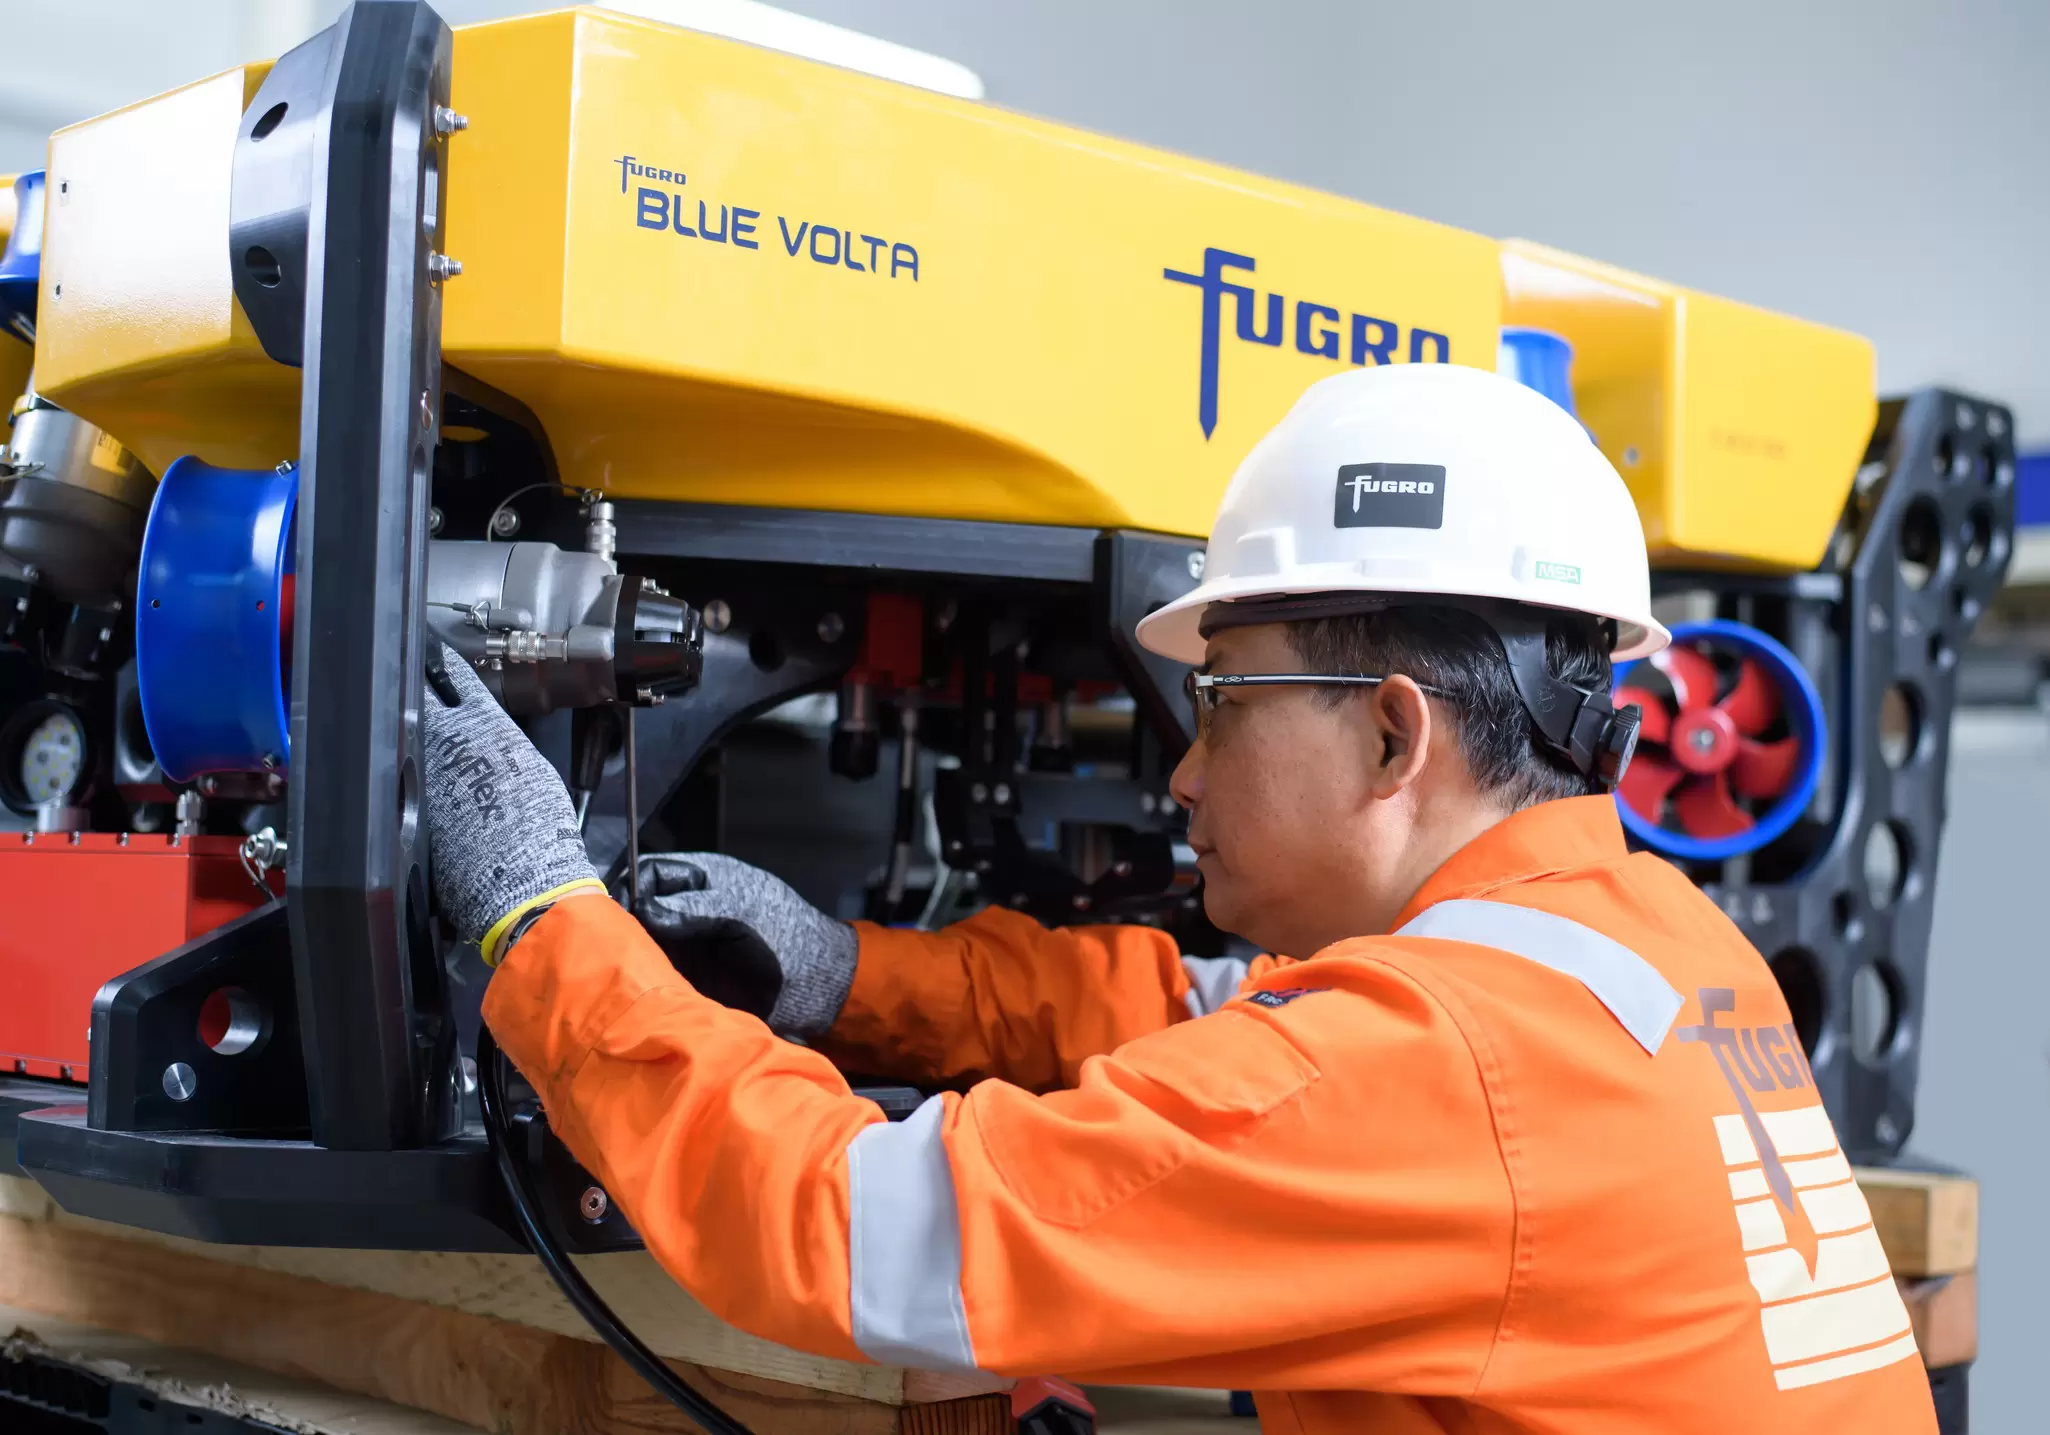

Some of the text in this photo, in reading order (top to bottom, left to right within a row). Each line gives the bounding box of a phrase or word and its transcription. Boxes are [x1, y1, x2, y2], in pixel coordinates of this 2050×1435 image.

[636, 186, 919, 282] BLUE VOLTA
[1537, 562, 1580, 584] MSA
